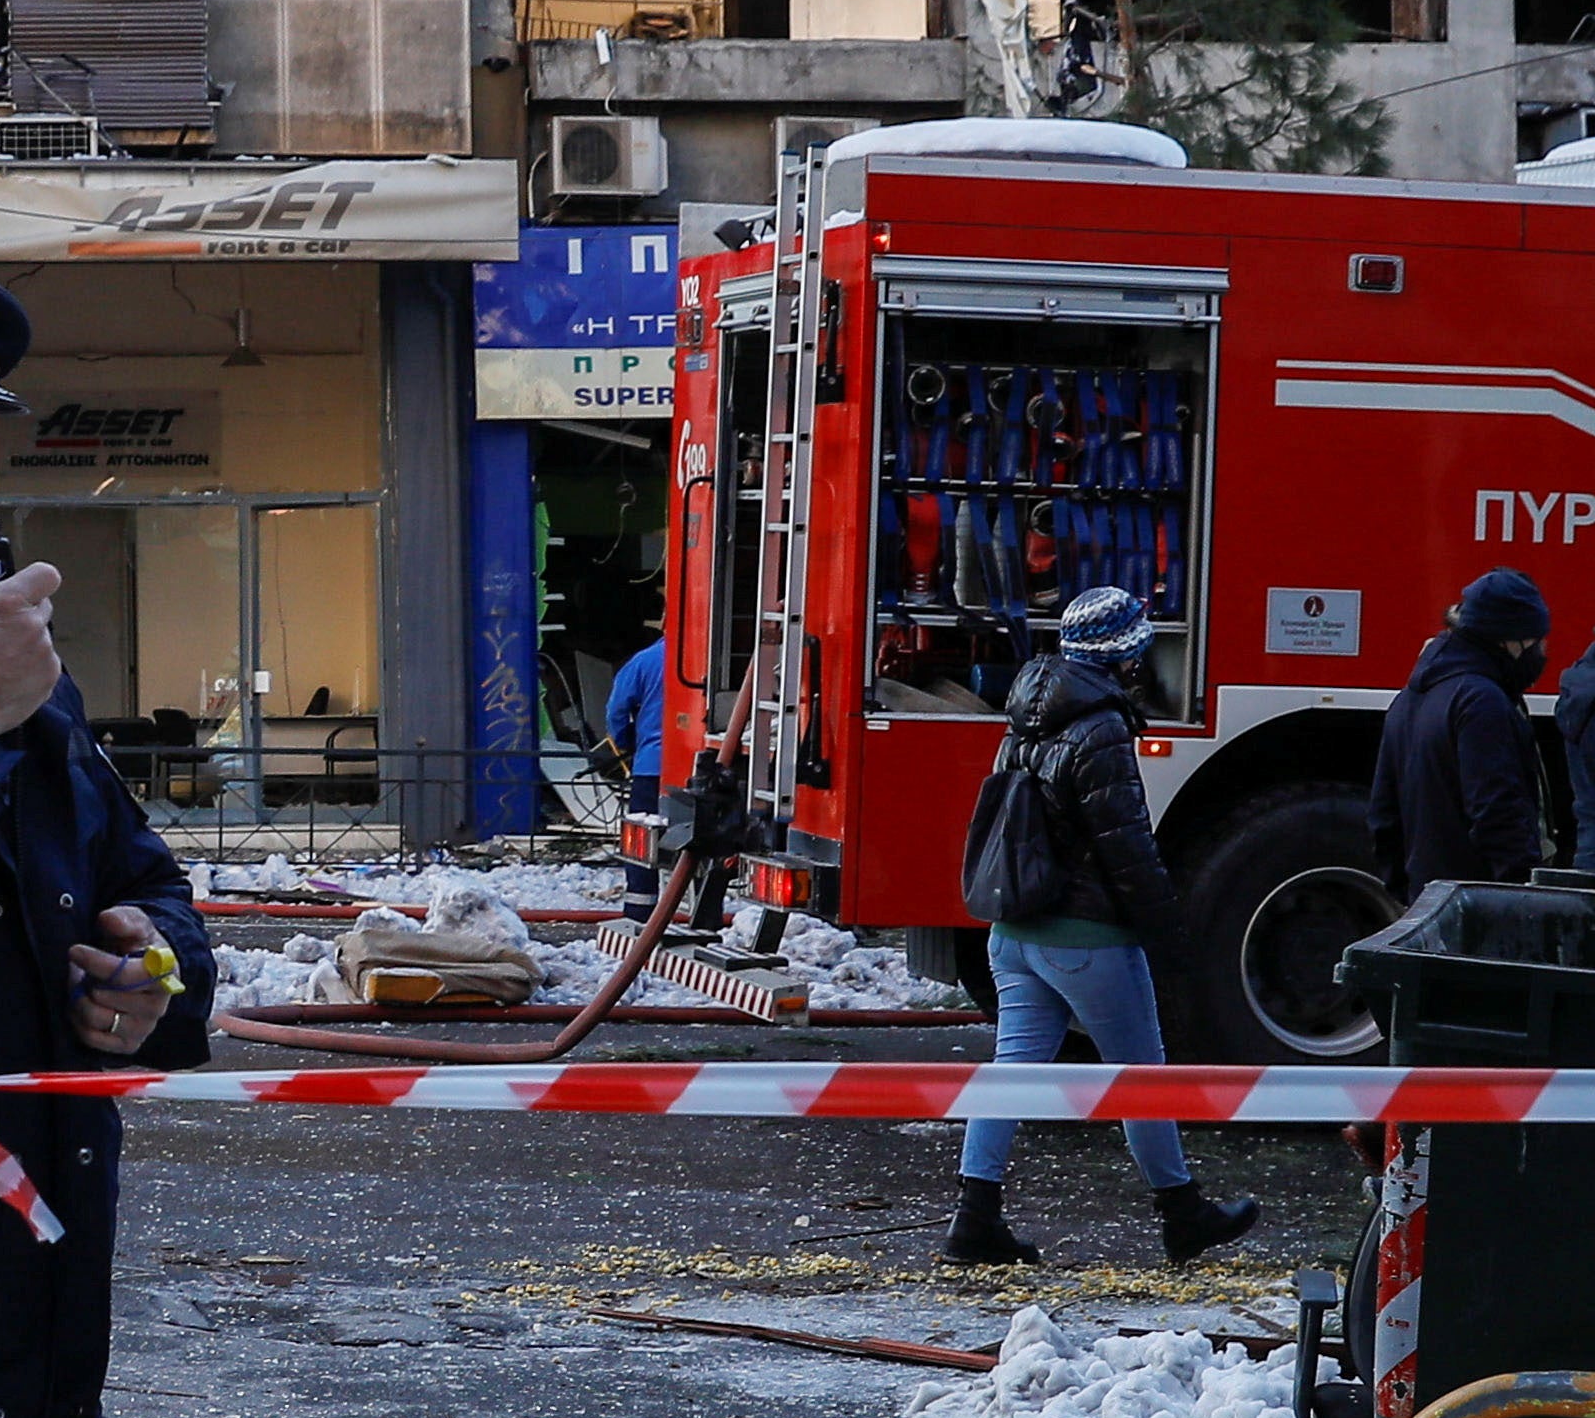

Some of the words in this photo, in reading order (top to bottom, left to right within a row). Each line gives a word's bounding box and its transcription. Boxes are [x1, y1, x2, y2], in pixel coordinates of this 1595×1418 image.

[207, 239, 267, 256] rent
[278, 241, 295, 255] a
[304, 239, 351, 255] car
[574, 387, 674, 407] SUPER
[11, 454, 97, 468] ΕΝΟΙΚΙΑΣΕΙΣ
[106, 454, 209, 468] ΑΥΤΟΚΙΝΗΤΩΝ
